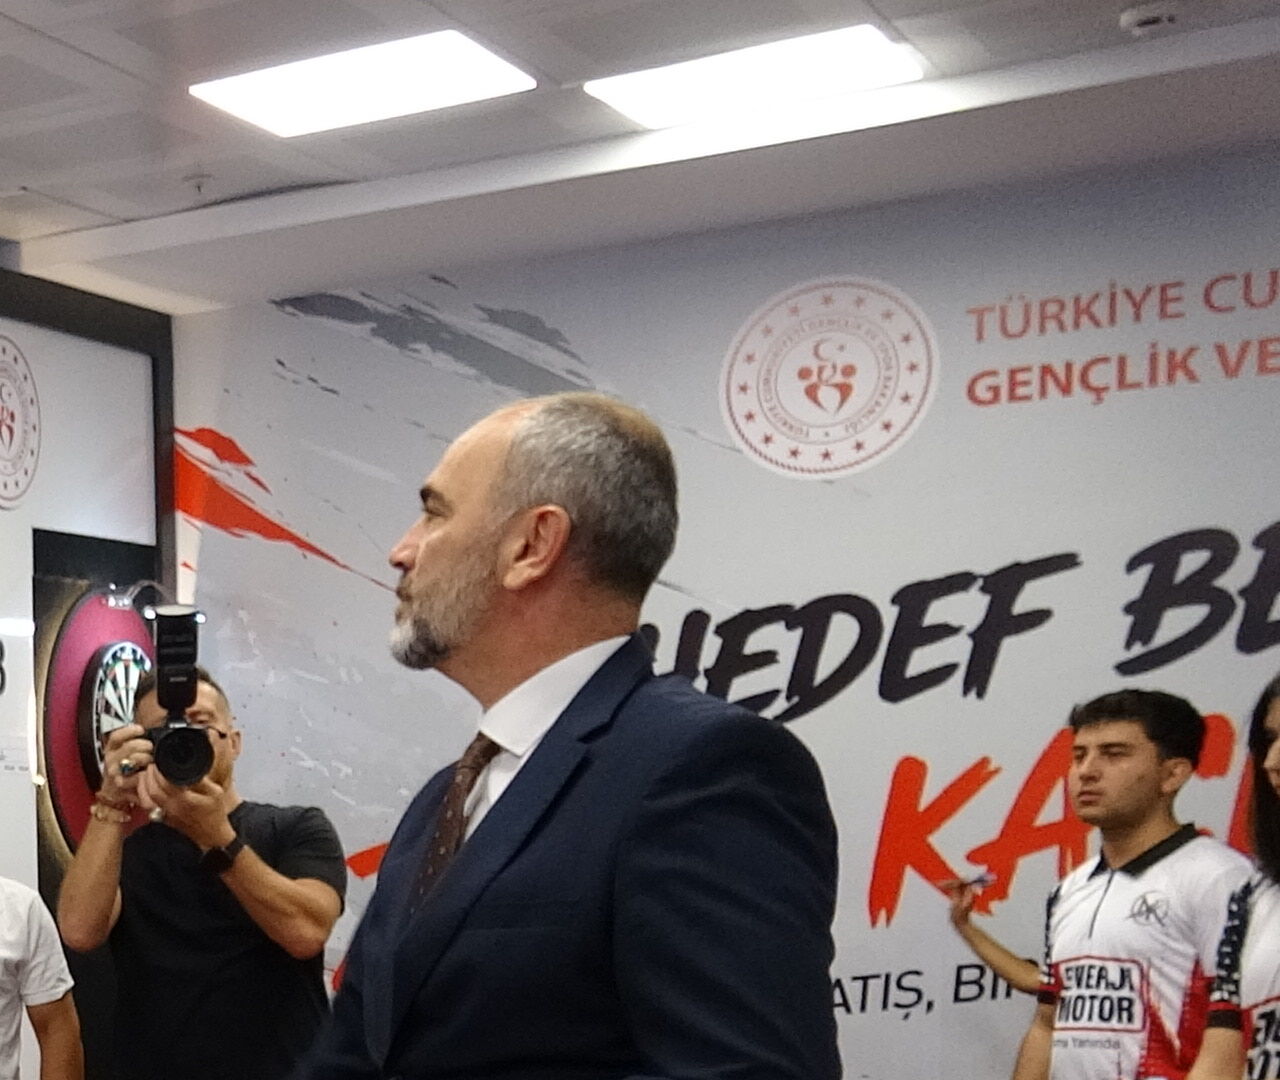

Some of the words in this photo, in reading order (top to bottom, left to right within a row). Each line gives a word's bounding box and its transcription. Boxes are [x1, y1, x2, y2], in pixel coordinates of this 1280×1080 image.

[966, 279, 1186, 344] TÜRKİYE
[966, 341, 1200, 407] GENÇLİK
[1057, 995, 1135, 1024] MOTOR
